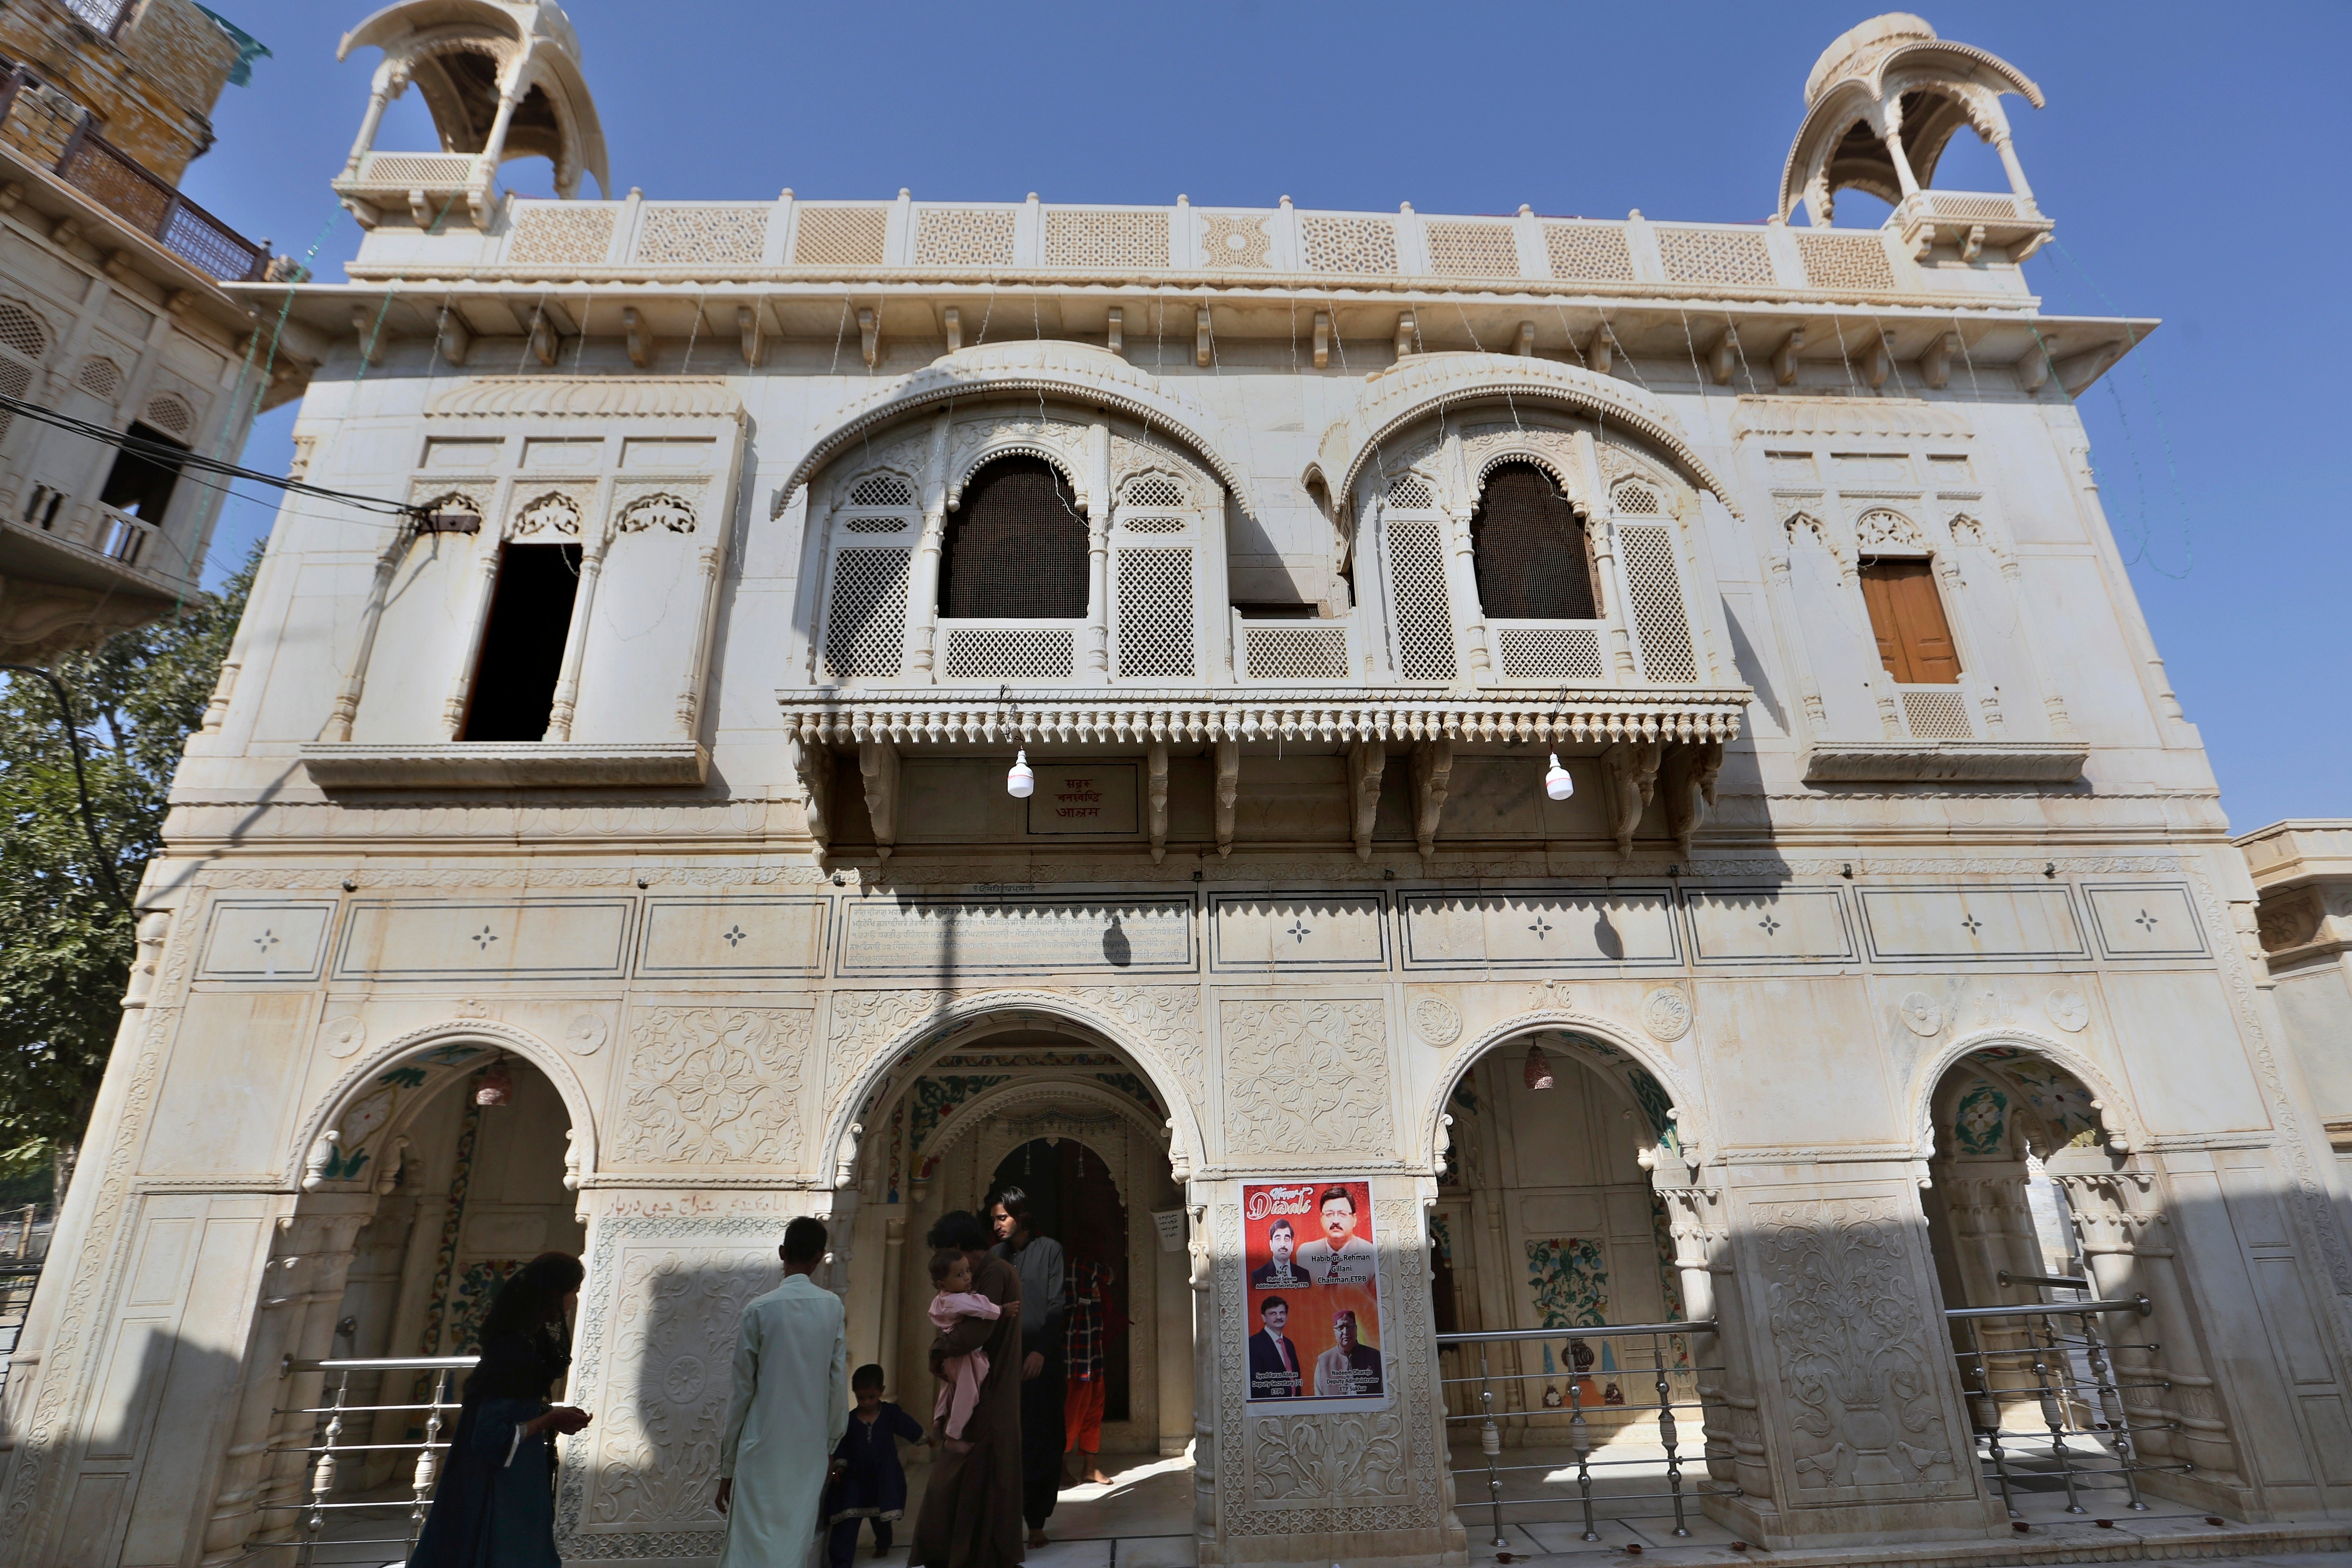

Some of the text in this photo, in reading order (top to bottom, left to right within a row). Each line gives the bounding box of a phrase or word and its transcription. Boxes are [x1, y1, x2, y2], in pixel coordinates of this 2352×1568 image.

[1055, 807, 1101, 818] आश्रम
[1269, 1187, 1314, 1200] Happy
[1247, 1191, 1312, 1220] Diwali
